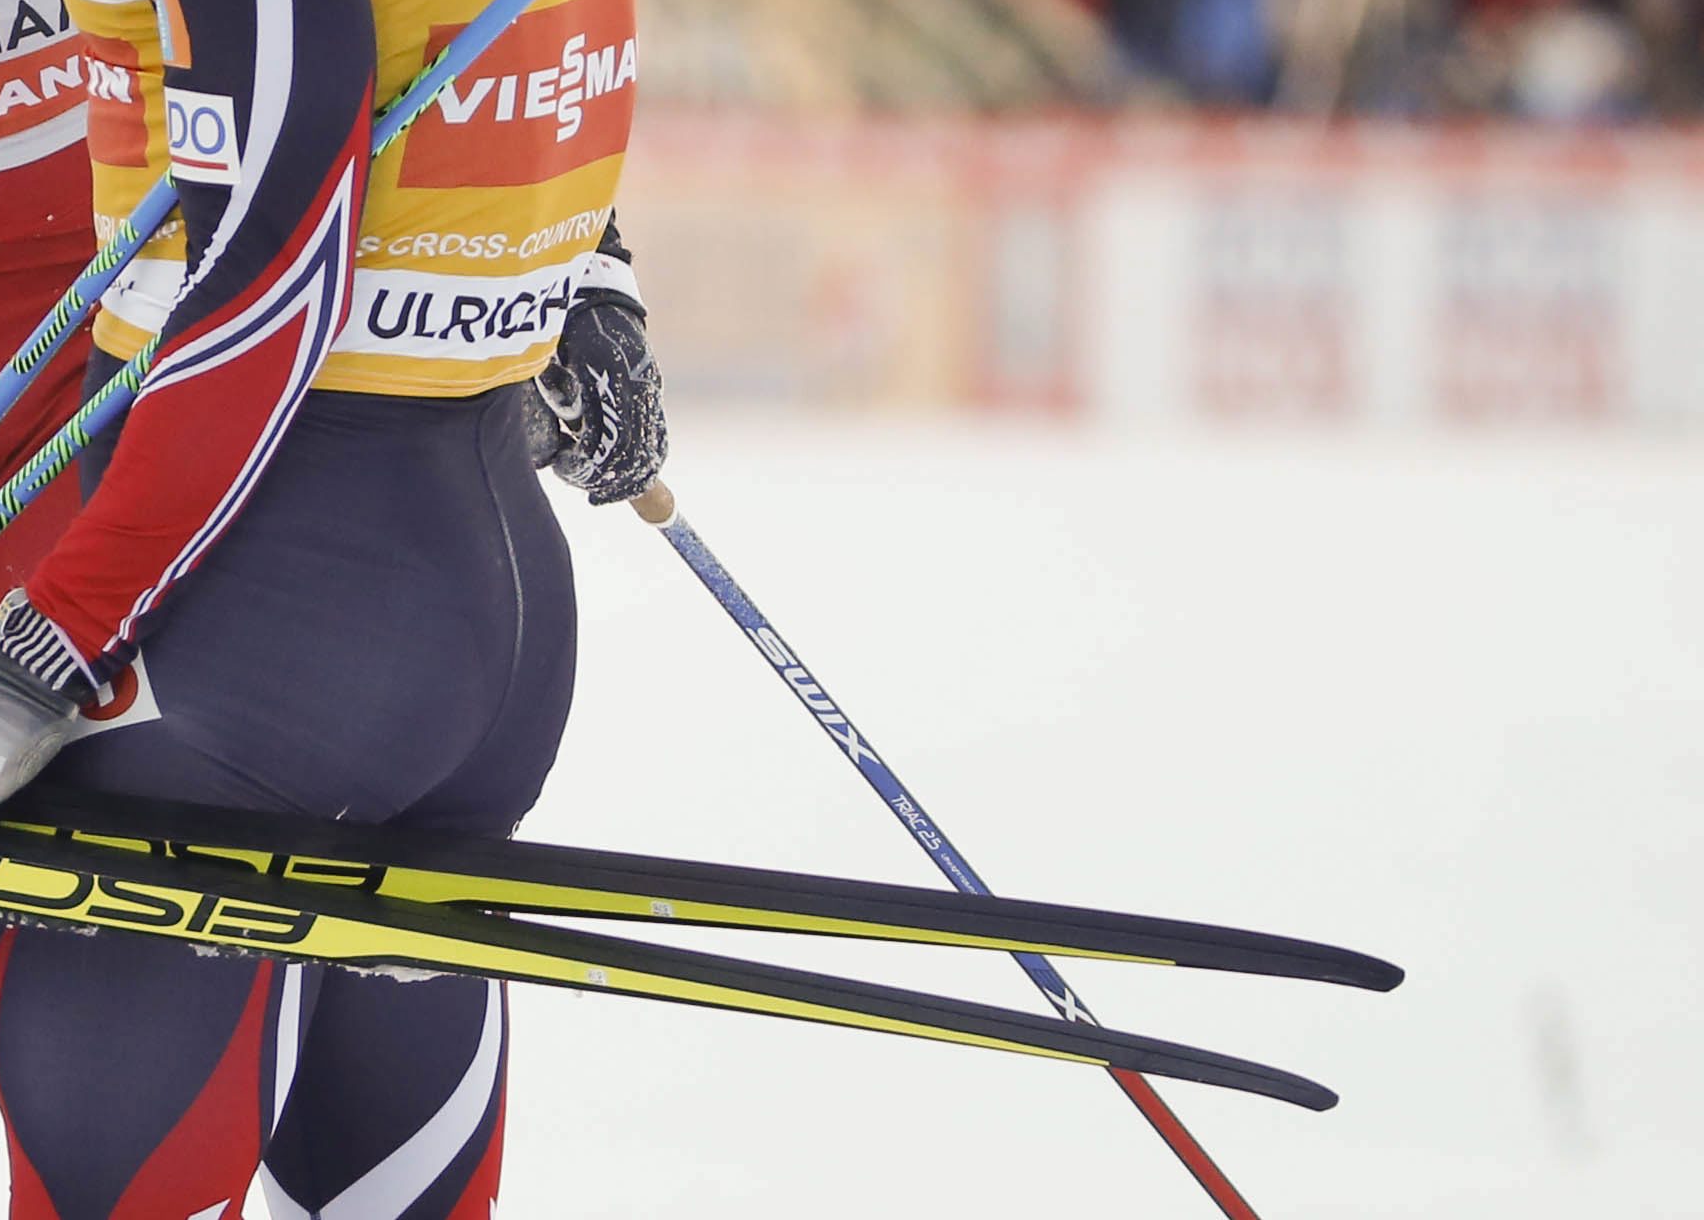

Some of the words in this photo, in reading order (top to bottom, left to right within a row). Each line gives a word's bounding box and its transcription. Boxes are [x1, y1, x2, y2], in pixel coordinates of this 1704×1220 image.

[387, 208, 603, 259] CROSS-COUNTRY
[891, 793, 929, 833] TRIAC
[918, 829, 941, 853] 25
